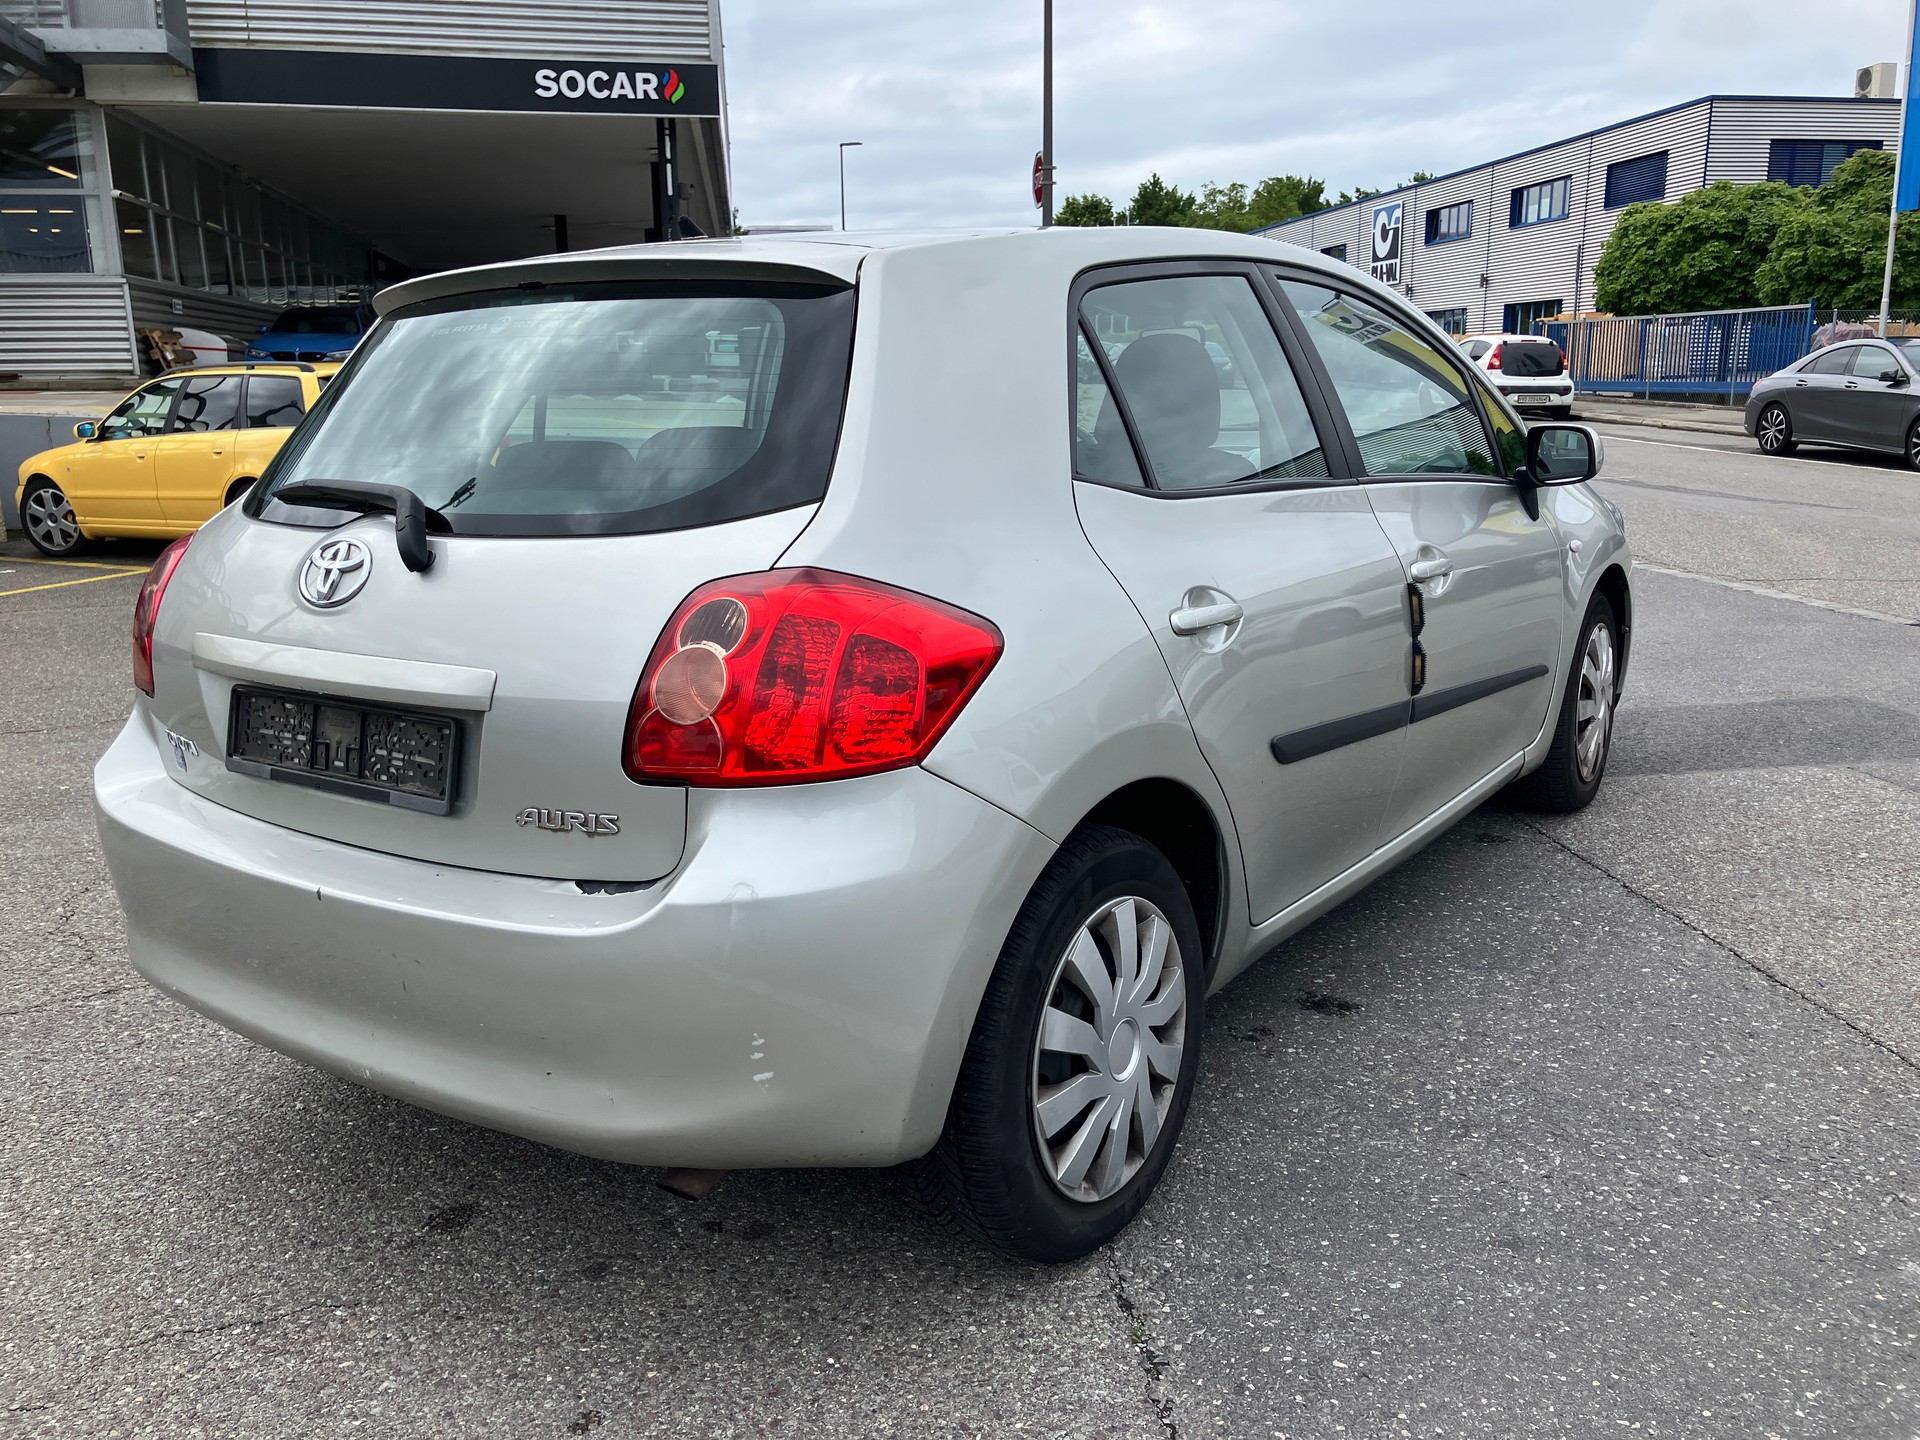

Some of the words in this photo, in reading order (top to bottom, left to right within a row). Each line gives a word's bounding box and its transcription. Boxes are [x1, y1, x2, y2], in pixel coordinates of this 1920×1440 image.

[534, 68, 660, 100] SOCAR
[452, 325, 474, 334] FREY
[516, 807, 620, 835] AURIS
